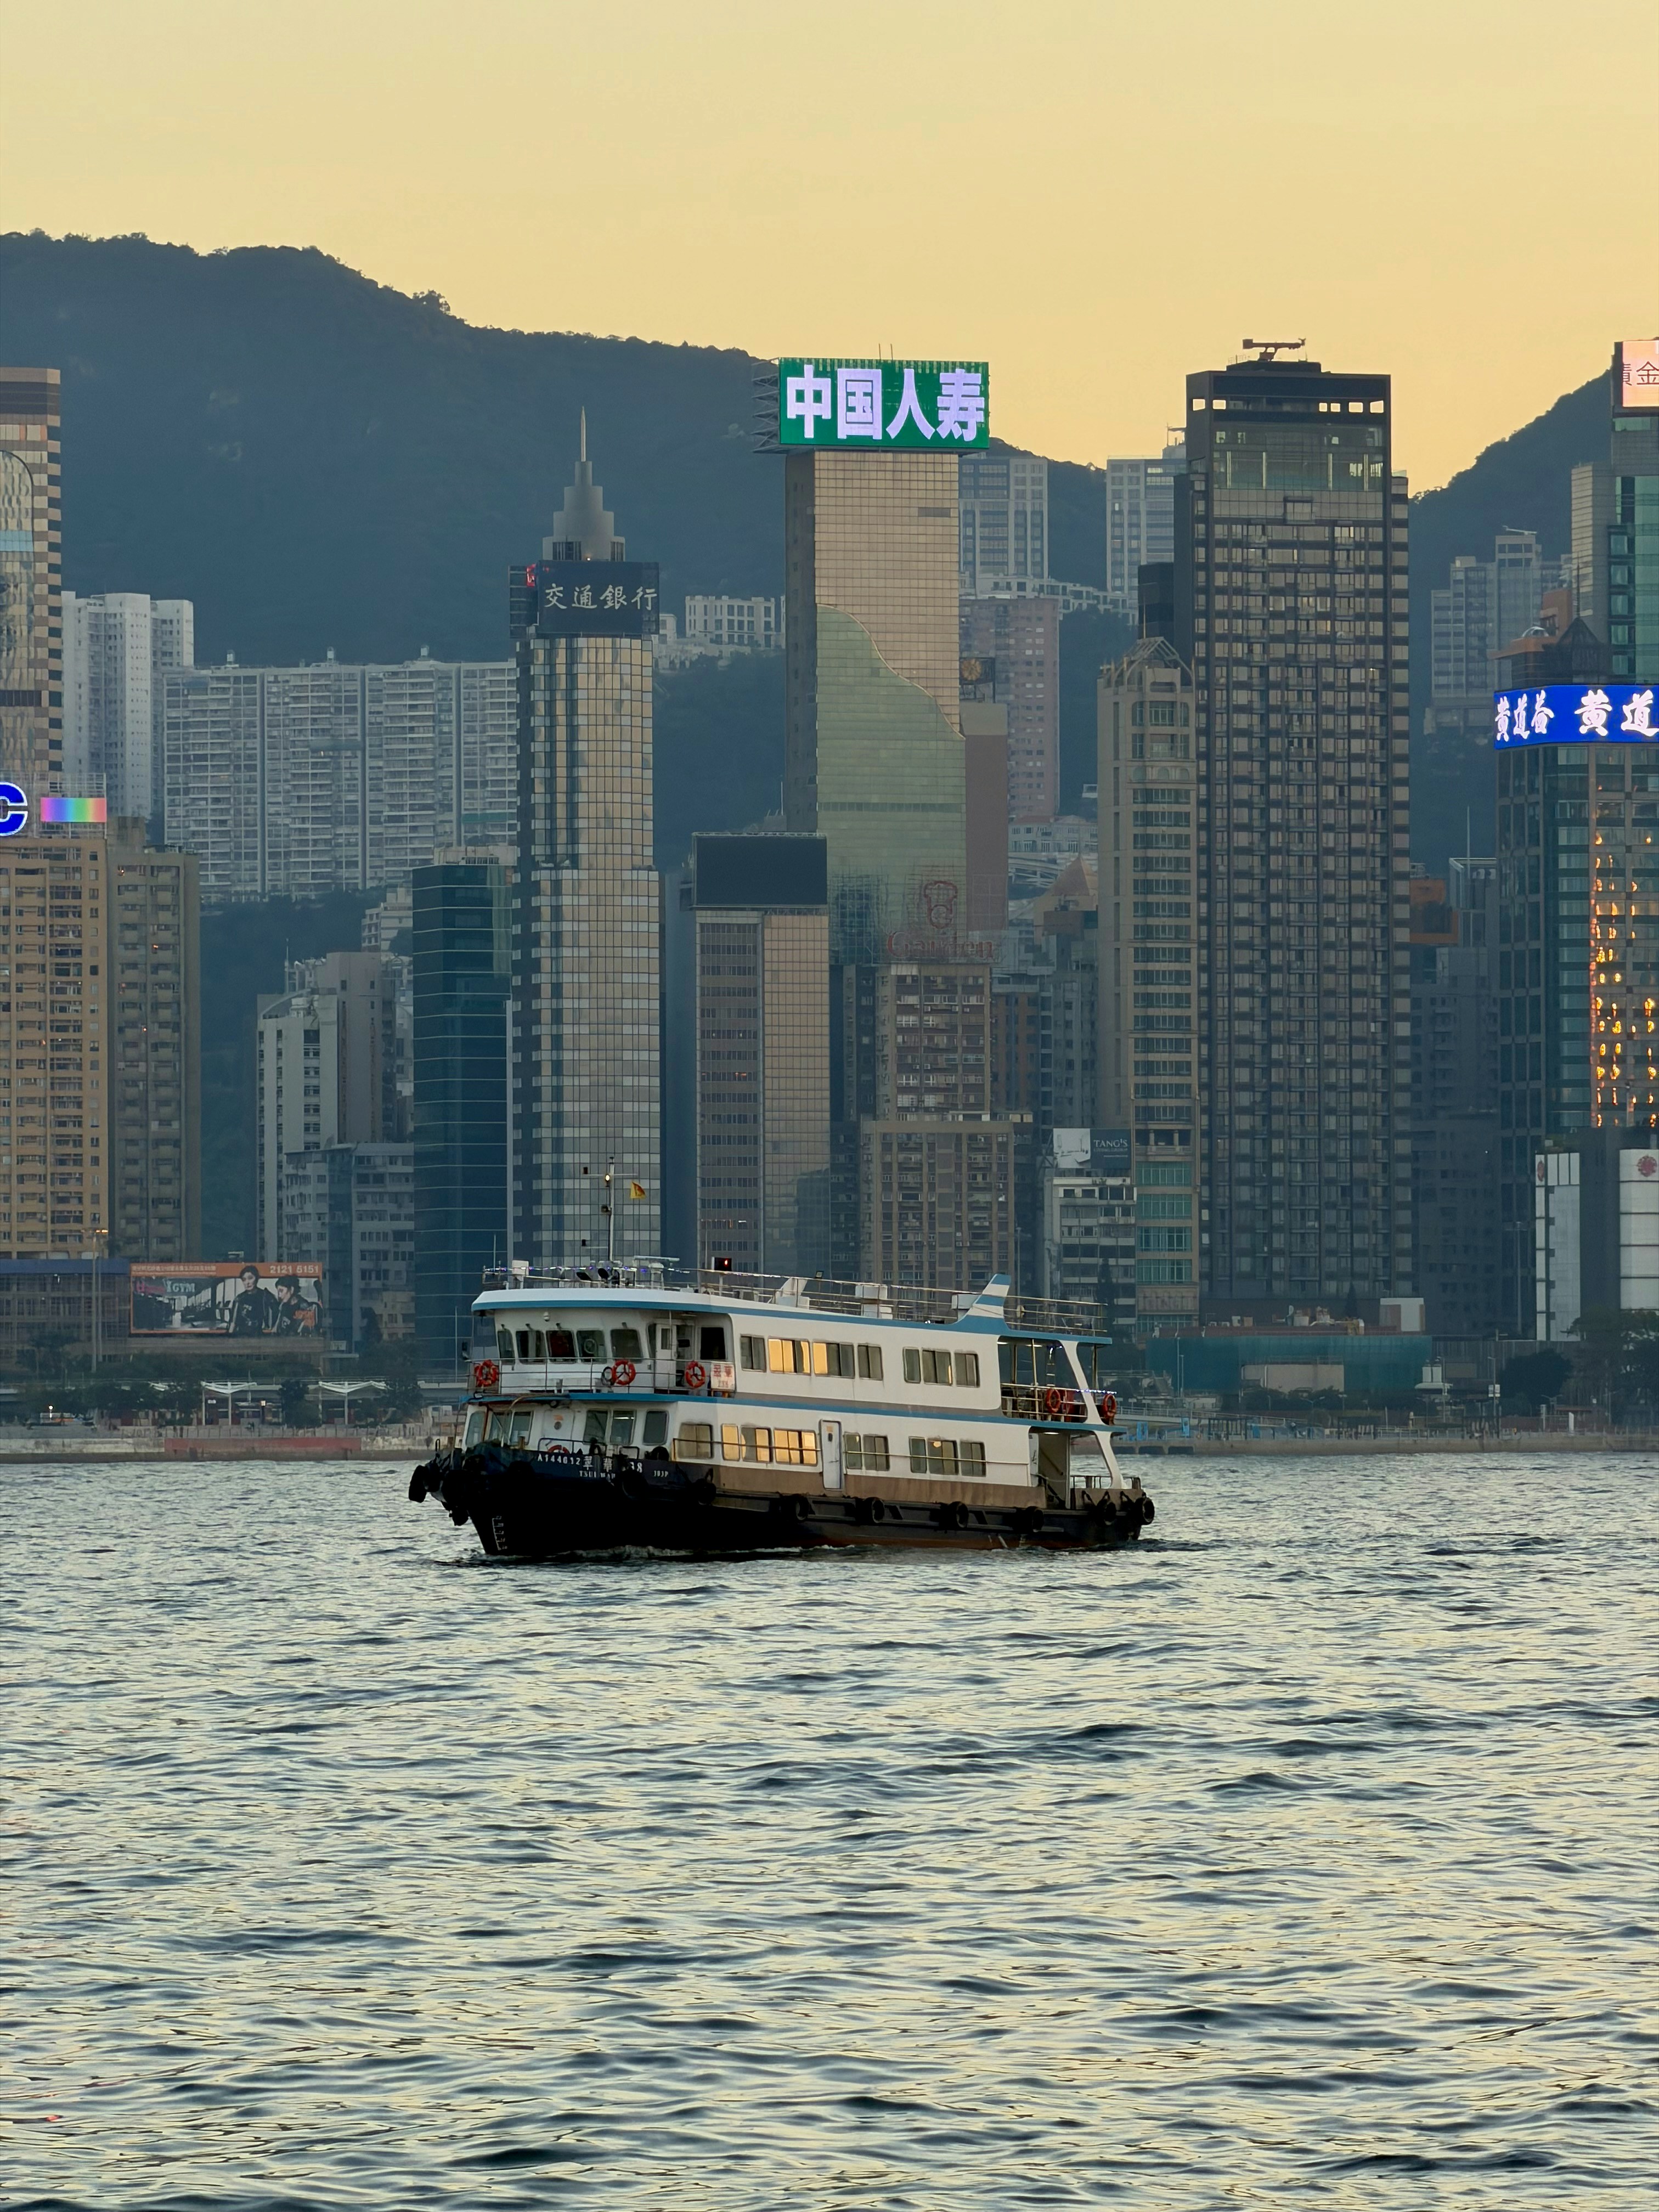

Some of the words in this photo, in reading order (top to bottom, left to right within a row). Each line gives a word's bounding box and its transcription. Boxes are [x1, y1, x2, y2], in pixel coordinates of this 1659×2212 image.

[787, 364, 985, 442] 中国人寿
[544, 583, 657, 611] 交通銀行
